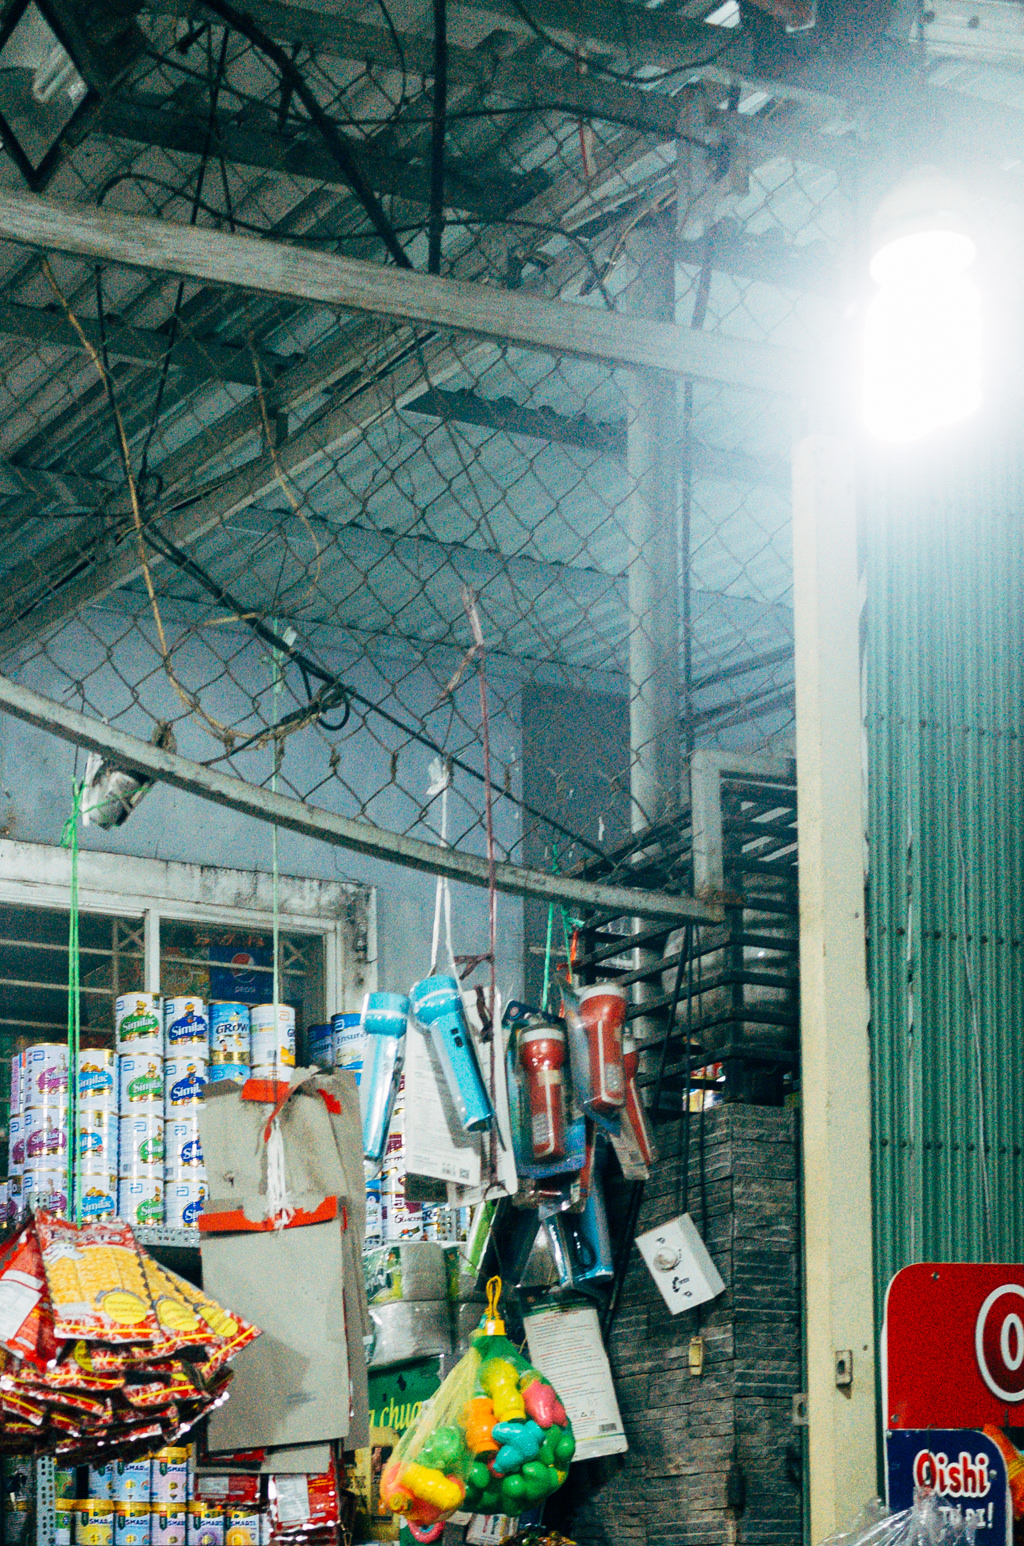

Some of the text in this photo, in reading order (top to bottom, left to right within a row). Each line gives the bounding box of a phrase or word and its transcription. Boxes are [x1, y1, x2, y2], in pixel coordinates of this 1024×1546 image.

[122, 1017, 157, 1032] Similac
[171, 1021, 207, 1038] Similac
[215, 1023, 249, 1035] GROW
[913, 1449, 991, 1498] Oishi
